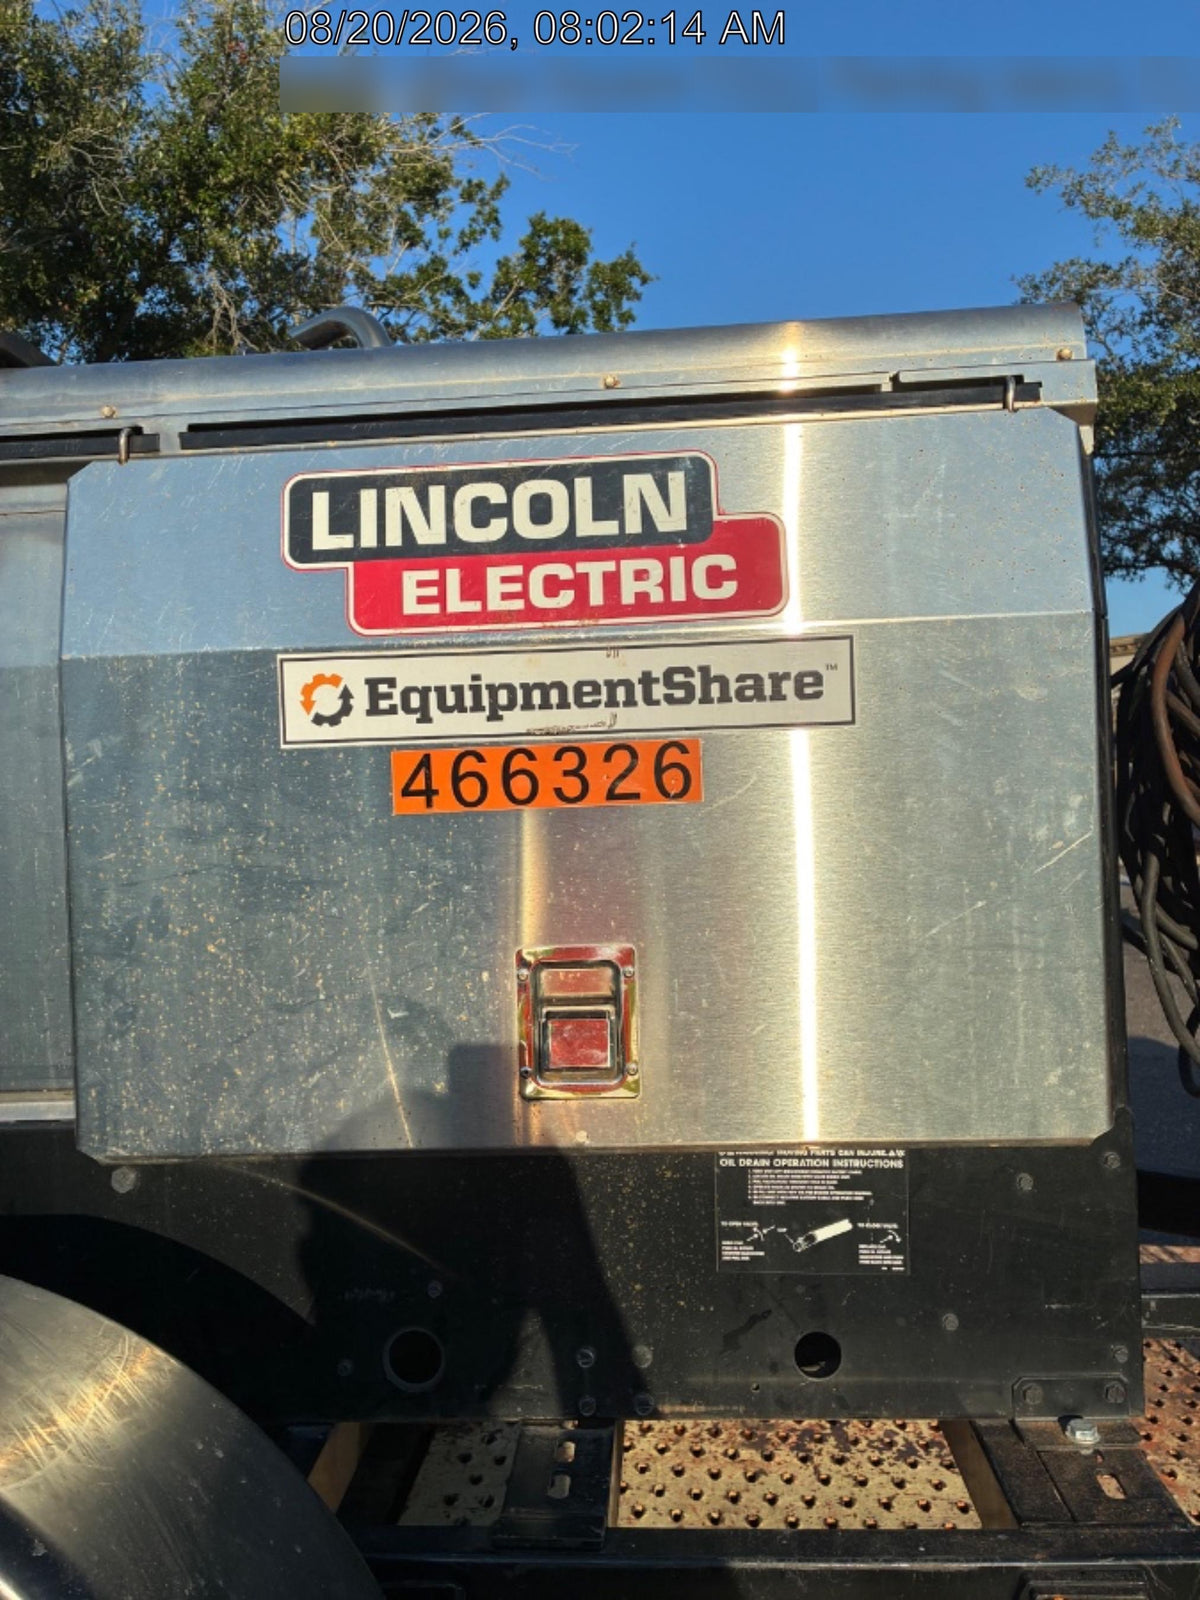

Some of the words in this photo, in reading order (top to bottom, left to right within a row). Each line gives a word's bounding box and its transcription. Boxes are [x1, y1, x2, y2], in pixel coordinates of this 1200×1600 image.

[311, 471, 688, 550] LINCOLN
[402, 556, 739, 616] ELECTRIC
[364, 665, 824, 723] EquipmentShare
[400, 741, 693, 810] 466326
[719, 1158, 736, 1167] OIL
[739, 1158, 770, 1167] DRAIN
[773, 1158, 829, 1167] OPERATION
[832, 1158, 904, 1169] INSTRUCTIONS
